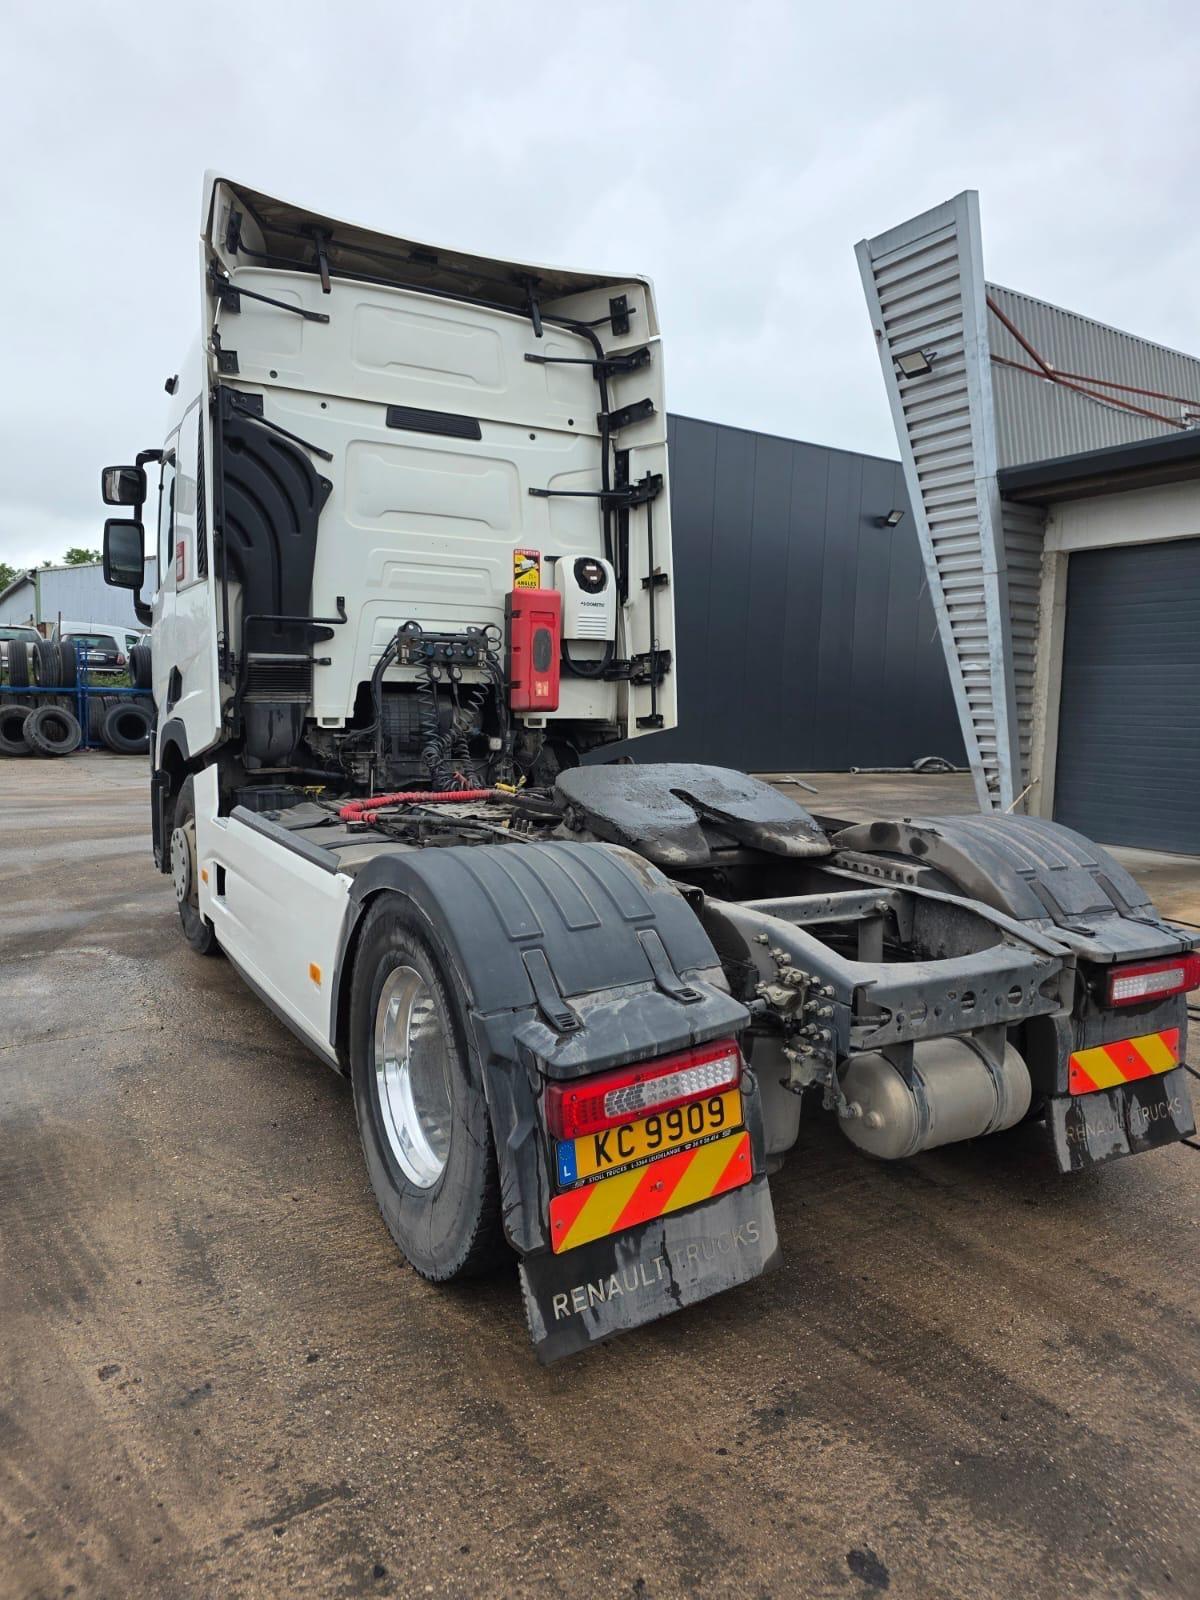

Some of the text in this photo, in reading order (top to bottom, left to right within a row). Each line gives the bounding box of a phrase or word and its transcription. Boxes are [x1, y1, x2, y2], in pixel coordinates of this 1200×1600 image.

[1134, 1097, 1183, 1126] TRUCKS
[594, 1096, 725, 1168] KC 9909
[563, 1165, 571, 1177] L
[588, 1172, 605, 1183] STOLL
[606, 1165, 628, 1177] TRUCKS
[551, 1219, 760, 1321] RENAULT TRUCKS
